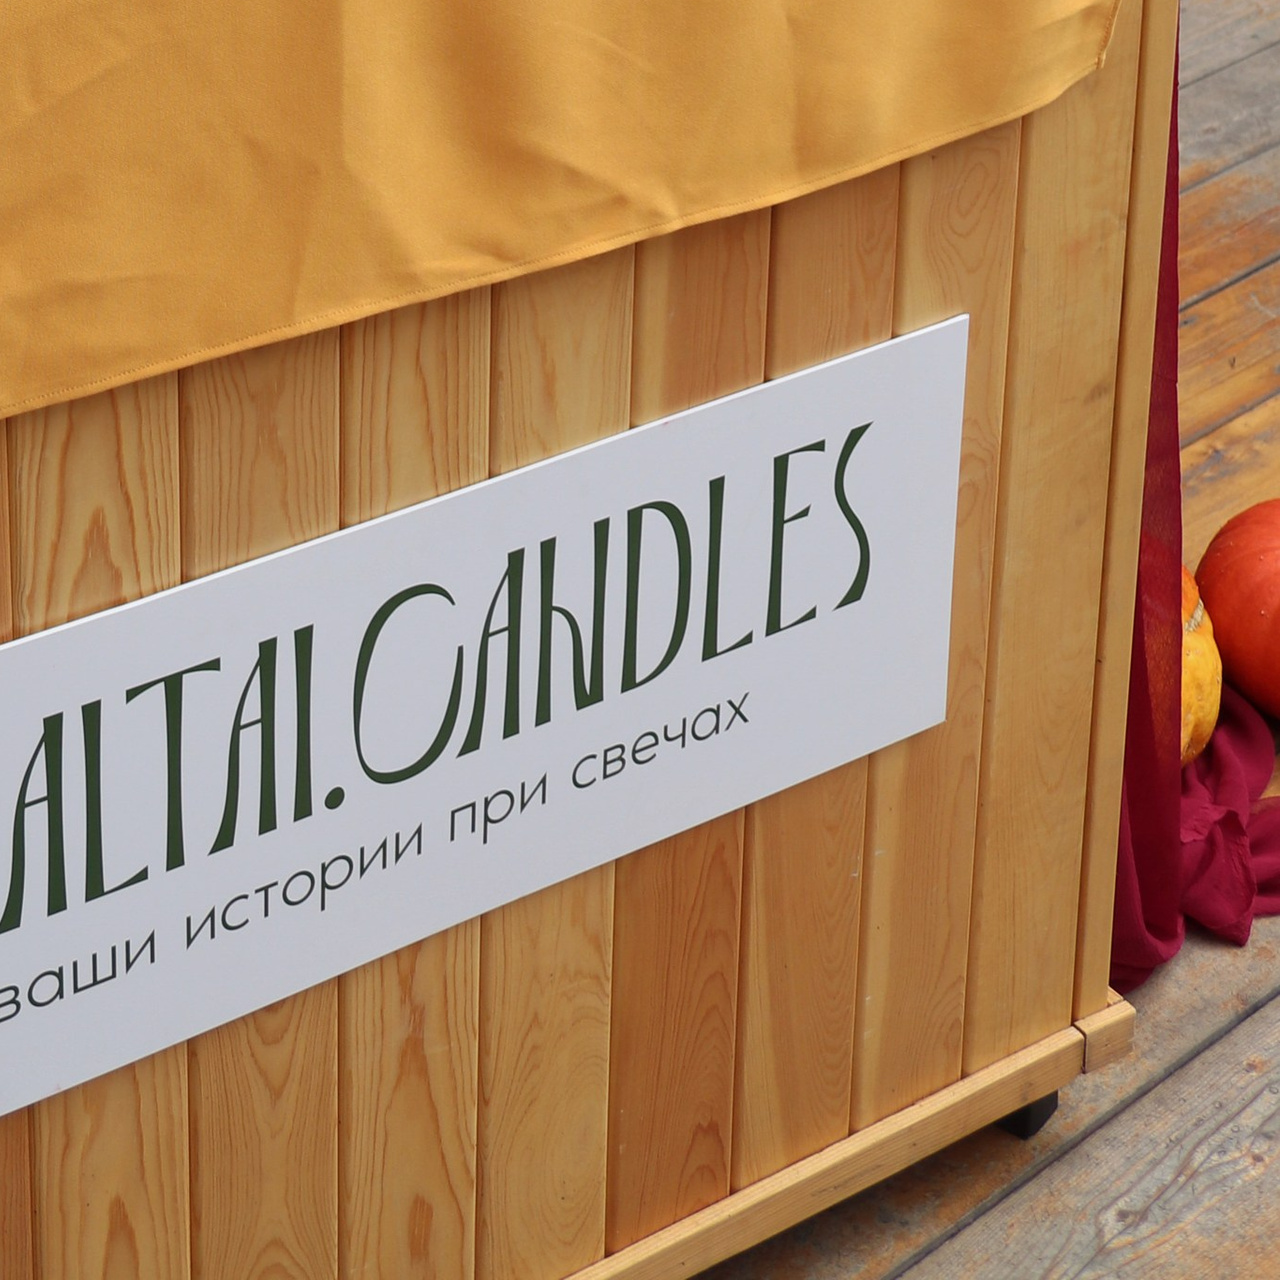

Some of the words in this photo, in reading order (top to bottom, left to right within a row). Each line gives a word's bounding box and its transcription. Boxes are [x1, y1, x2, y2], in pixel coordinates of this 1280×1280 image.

[185, 824, 426, 953] истории
[447, 766, 549, 845] при
[569, 689, 752, 792] свечах
